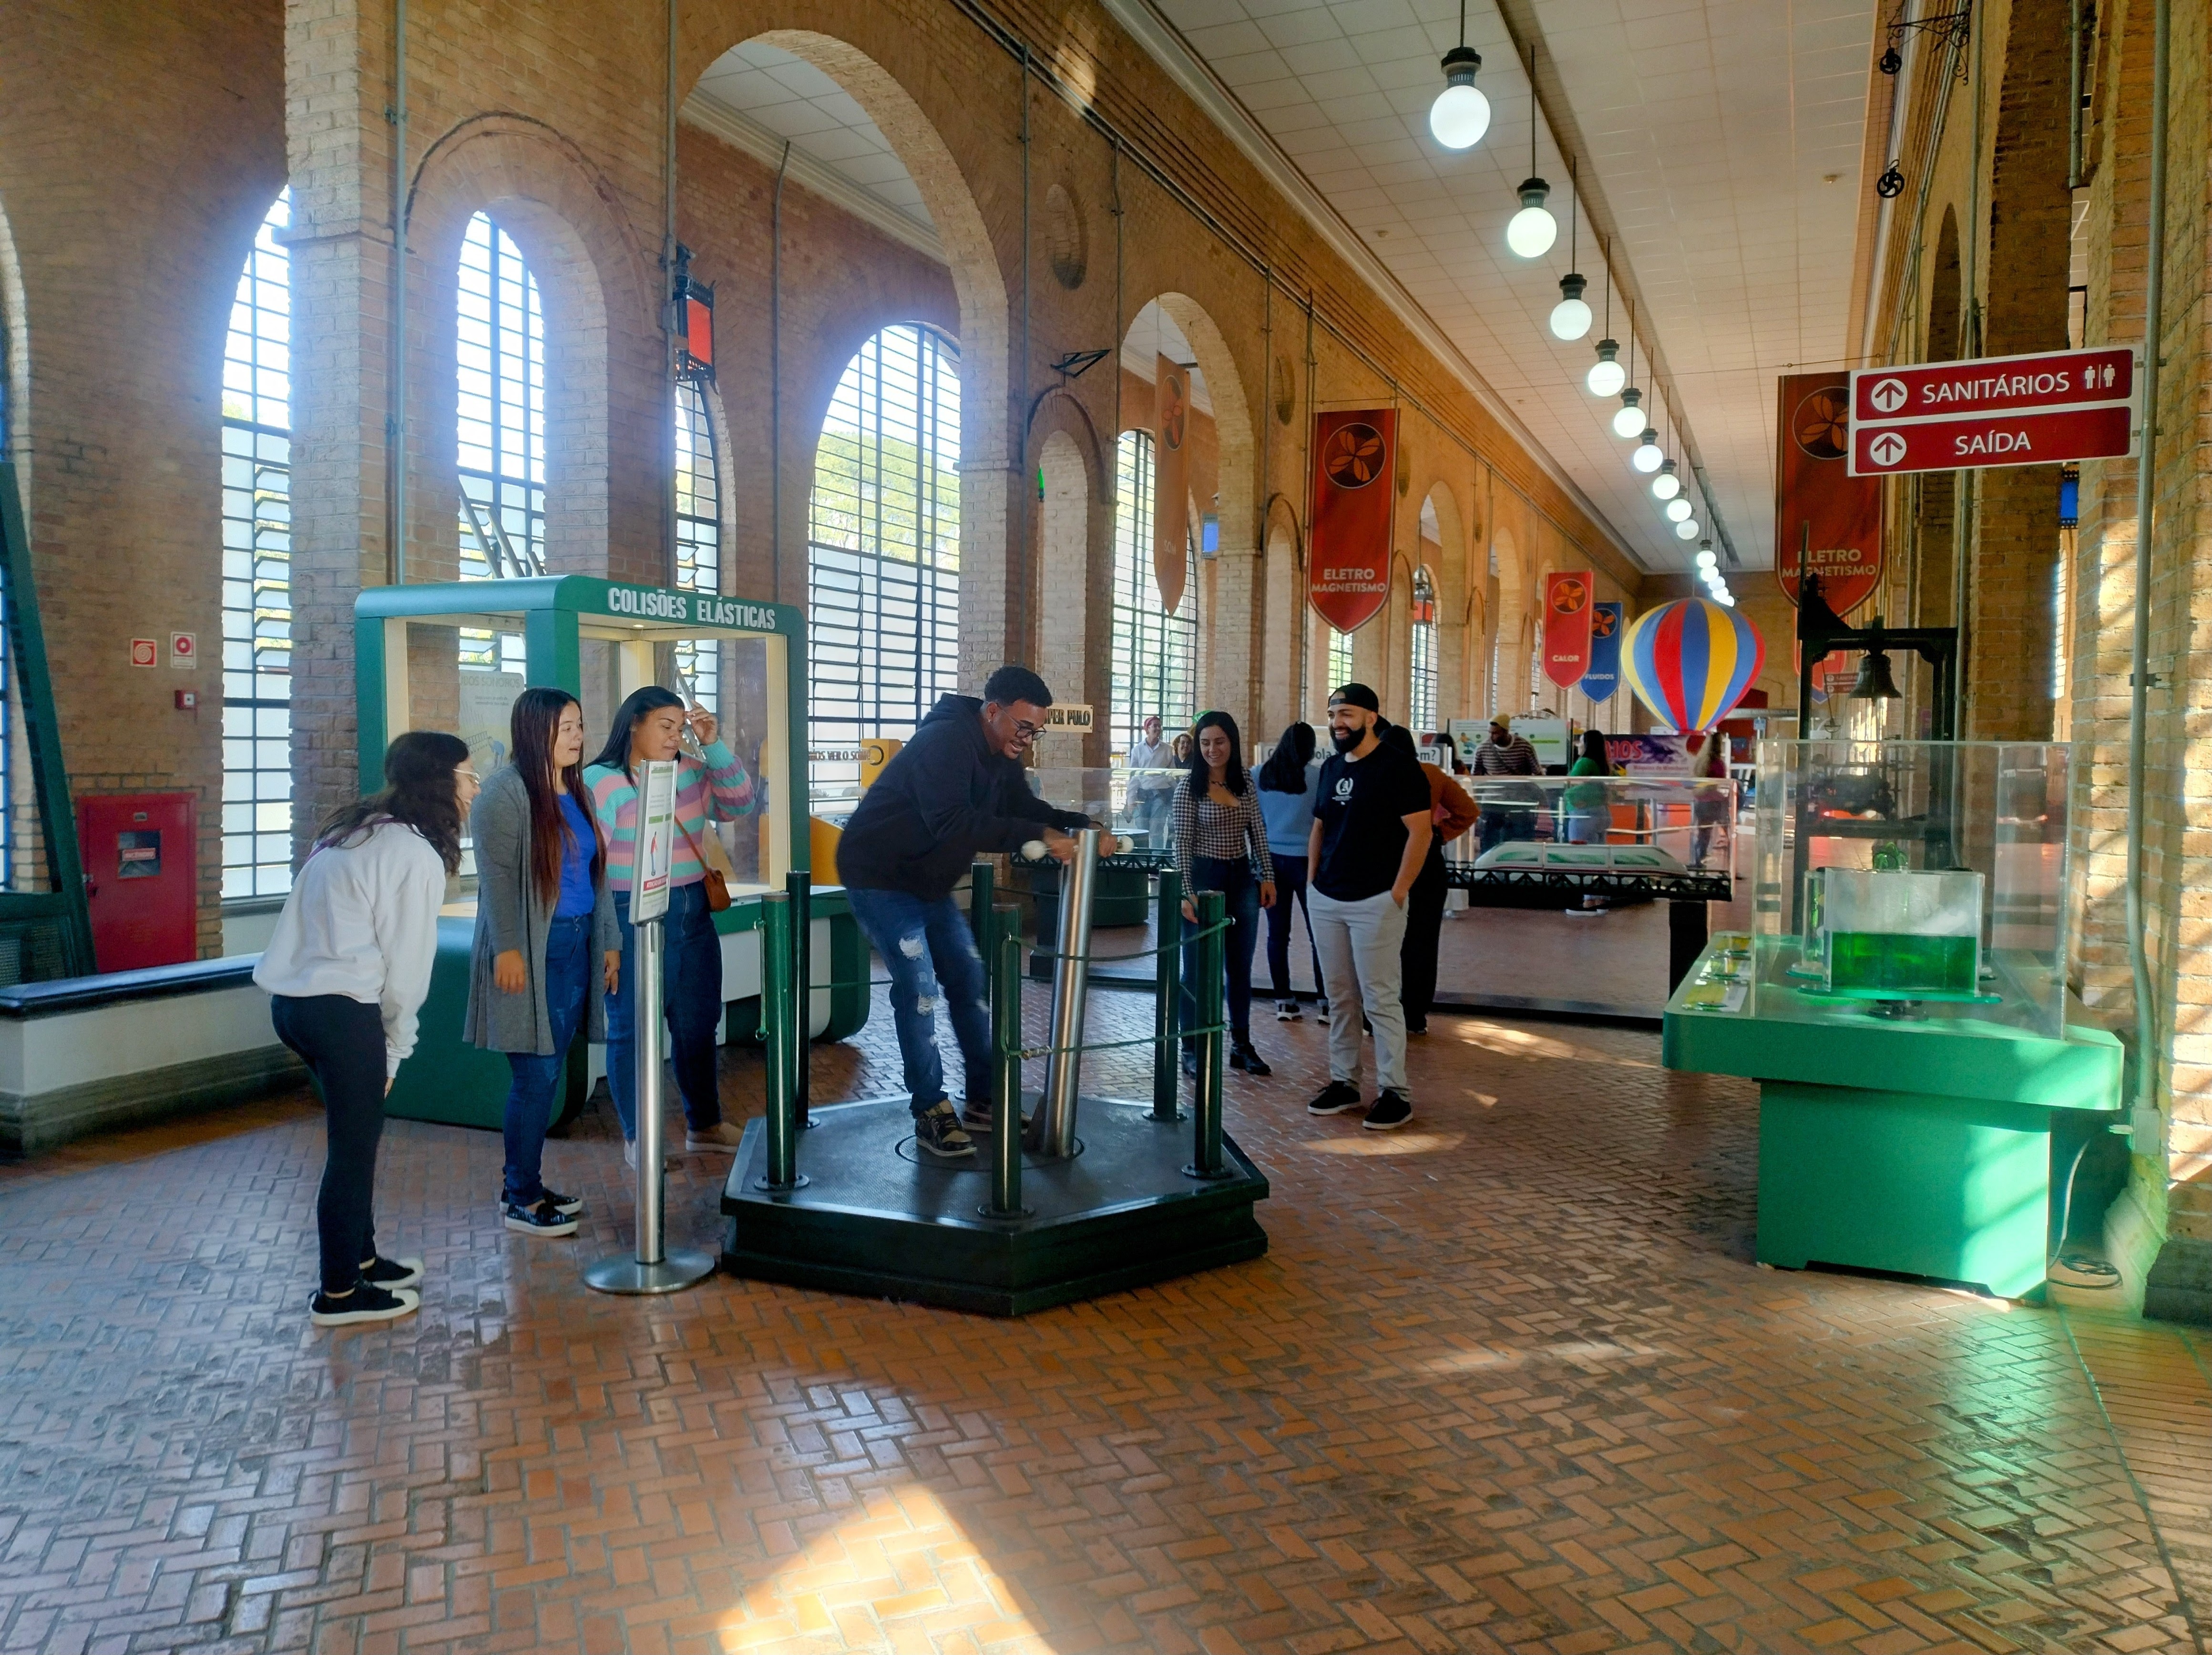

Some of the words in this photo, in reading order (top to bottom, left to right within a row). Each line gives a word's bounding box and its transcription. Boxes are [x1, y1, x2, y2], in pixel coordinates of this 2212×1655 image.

[1922, 372, 2070, 404] SANITÁRIOS
[1955, 431, 2032, 455] SAÍDA
[1323, 568, 1375, 580] ELETRO
[1311, 582, 1386, 593] MAGNETISMO
[608, 588, 686, 619] COLISÕES
[696, 596, 776, 630] ELÁSTICAS
[1044, 708, 1065, 725] PER
[1067, 709, 1091, 726] PULO
[842, 751, 849, 760] O
[1314, 748, 1331, 759] ola
